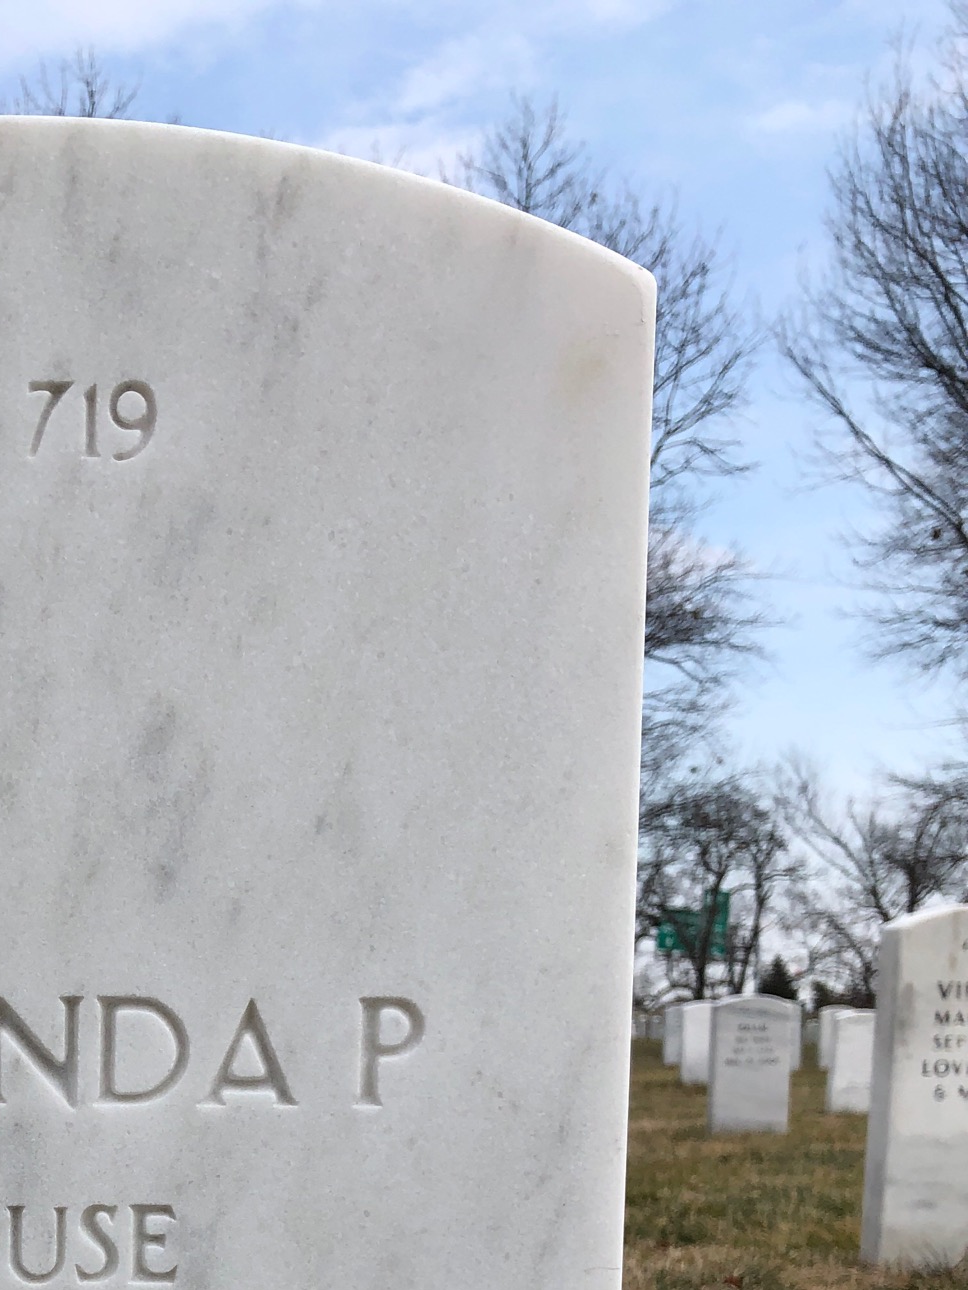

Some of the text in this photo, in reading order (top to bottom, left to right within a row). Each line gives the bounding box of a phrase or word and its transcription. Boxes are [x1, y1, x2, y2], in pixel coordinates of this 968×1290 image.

[28, 378, 158, 462] 719
[937, 980, 968, 1000] VI
[352, 995, 427, 1108] P
[921, 1059, 968, 1078] LOV
